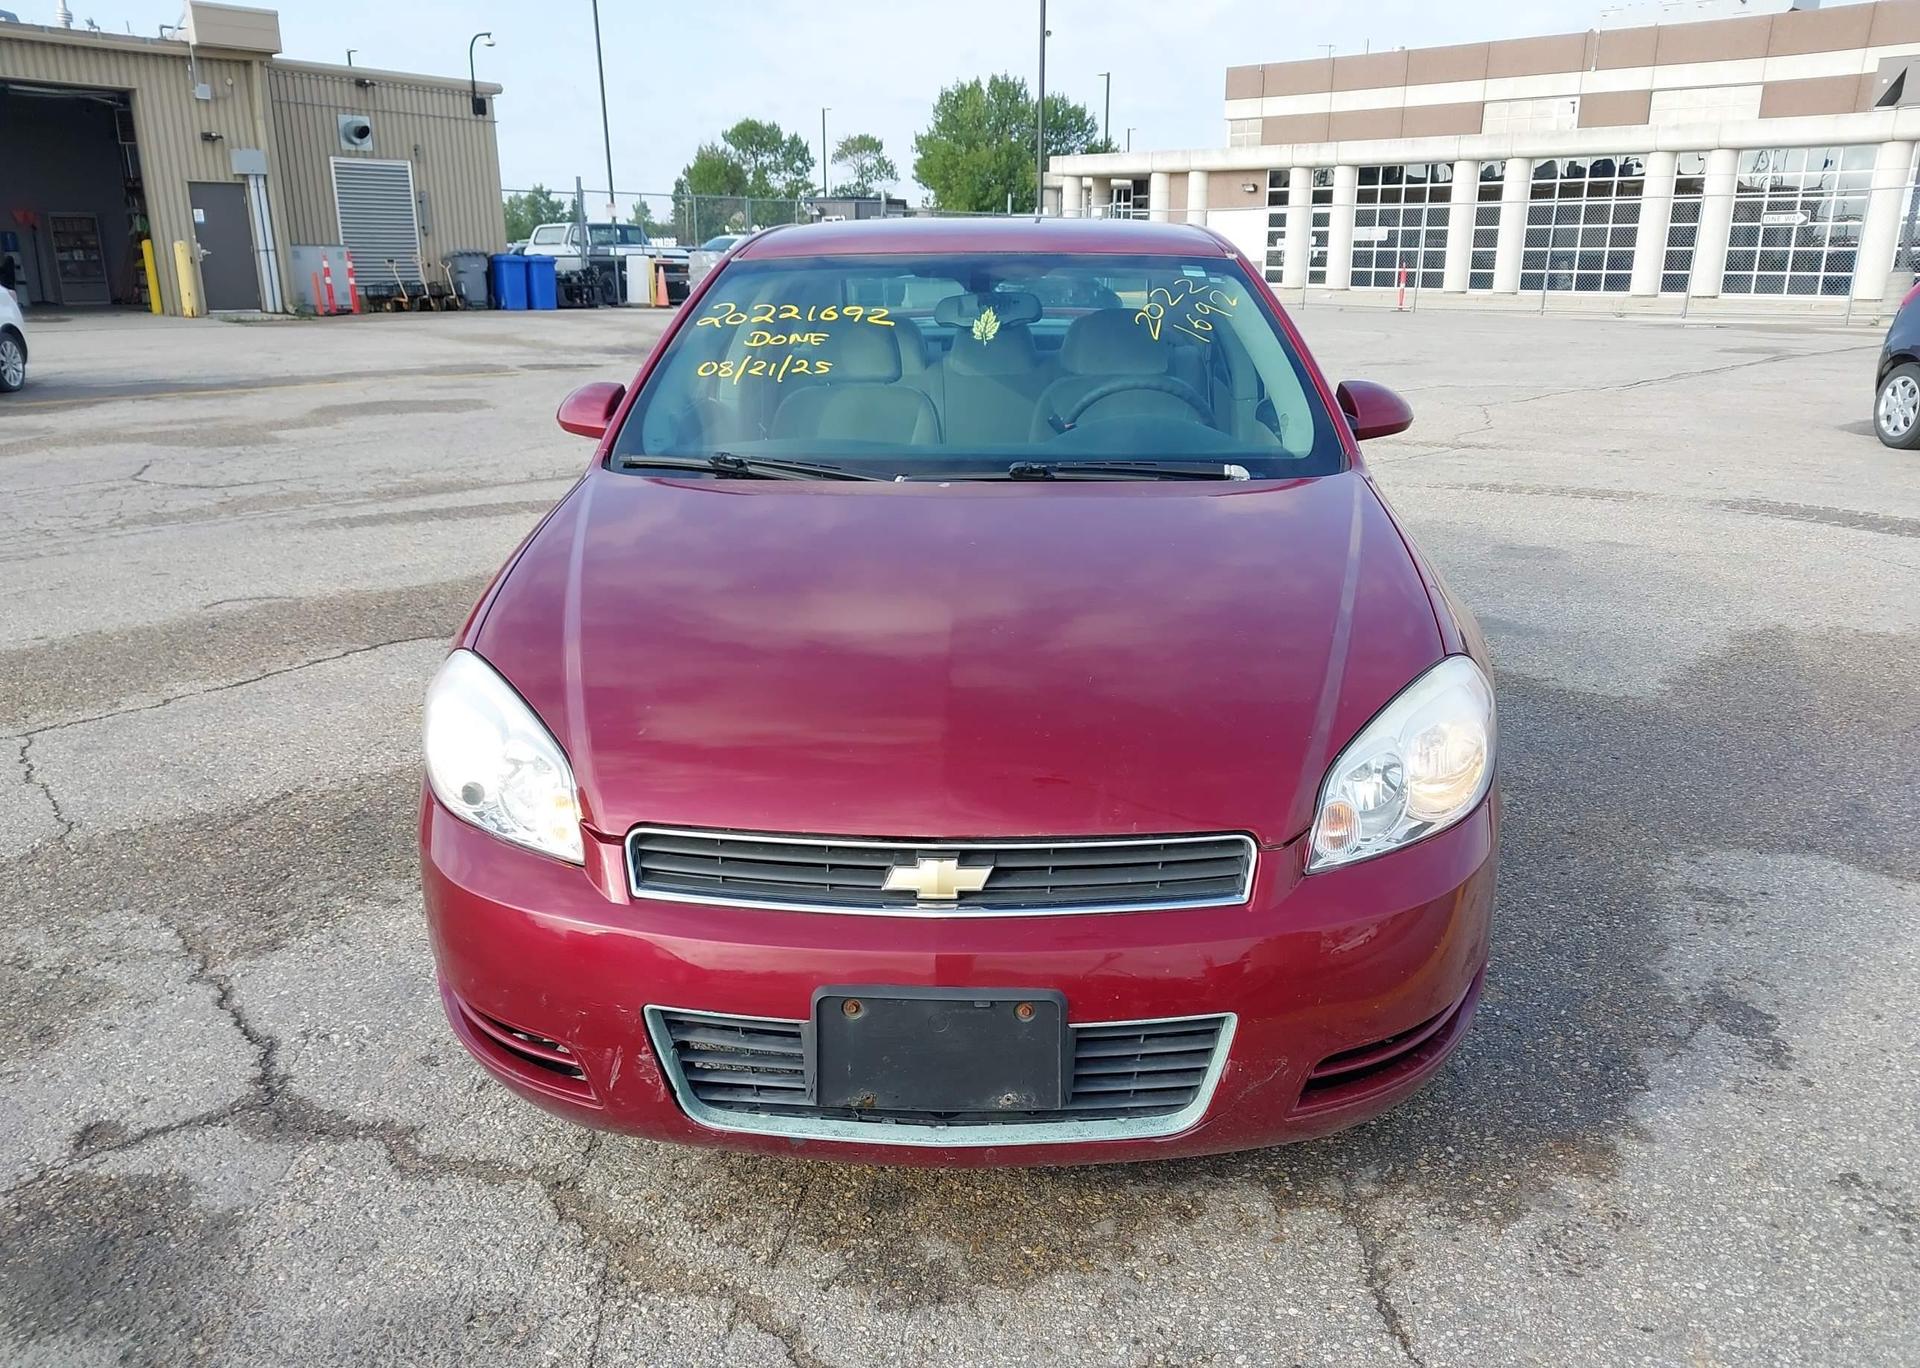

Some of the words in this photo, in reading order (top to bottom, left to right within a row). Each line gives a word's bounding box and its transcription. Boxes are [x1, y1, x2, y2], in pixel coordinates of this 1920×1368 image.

[696, 302, 896, 328] 20221692
[1135, 278, 1209, 341] 2022
[1173, 289, 1239, 343] 1692
[743, 330, 831, 348] DONE
[696, 354, 834, 386] 08/21/25
